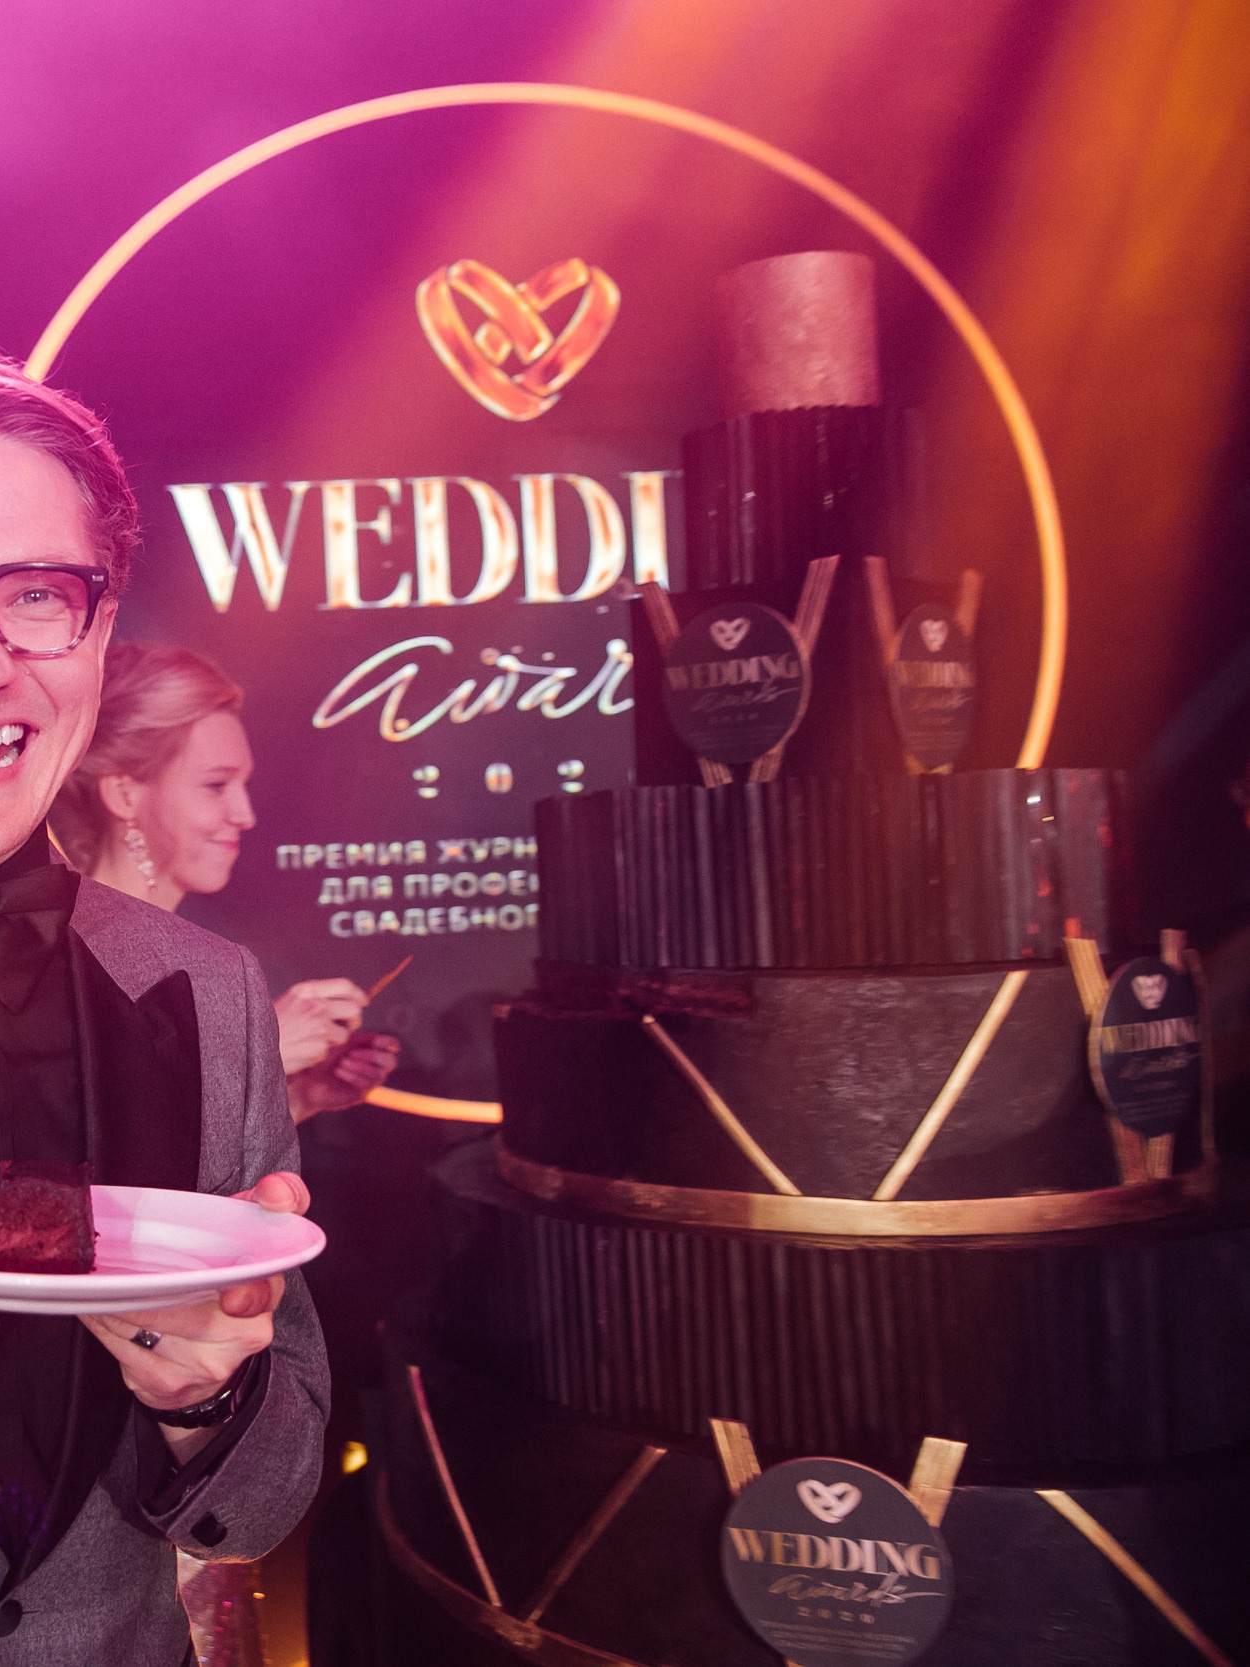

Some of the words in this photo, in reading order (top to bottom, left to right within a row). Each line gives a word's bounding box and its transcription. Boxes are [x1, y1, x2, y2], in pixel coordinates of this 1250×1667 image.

[276, 840, 427, 870] ПРЕМИЯ
[318, 875, 393, 904] ДЛЯ
[727, 1527, 942, 1580] WEDDING
